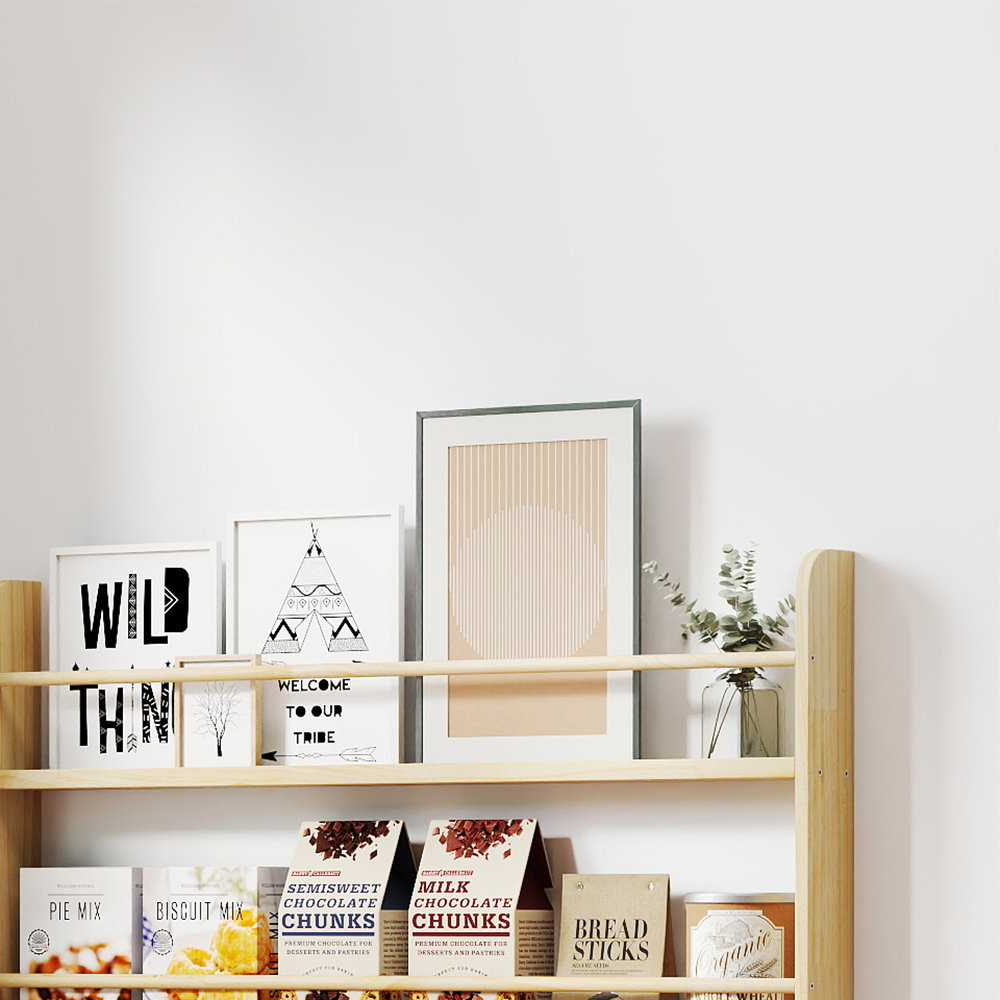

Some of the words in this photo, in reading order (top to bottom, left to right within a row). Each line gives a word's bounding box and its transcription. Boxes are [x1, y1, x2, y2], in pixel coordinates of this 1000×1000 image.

[80, 567, 190, 649] WILD
[278, 677, 351, 692] WELCOME
[70, 670, 176, 753] THIN
[286, 704, 306, 718] TO
[311, 704, 343, 718] OUR
[293, 730, 336, 744] TRIBE
[287, 883, 381, 894] SEMISWEET
[417, 880, 471, 893] MILK
[49, 901, 70, 921] PIE
[77, 901, 101, 921] MIX
[156, 901, 211, 921] BISCUIT
[219, 901, 244, 921] MIX
[283, 898, 378, 908] CHOCOLATE
[413, 898, 513, 908] CHOCOLATE
[281, 912, 375, 930] CHUNKS
[412, 912, 511, 930] CHUNKS
[574, 918, 648, 939] BREAD
[572, 940, 649, 961] STICKS
[696, 929, 772, 978] Organic
